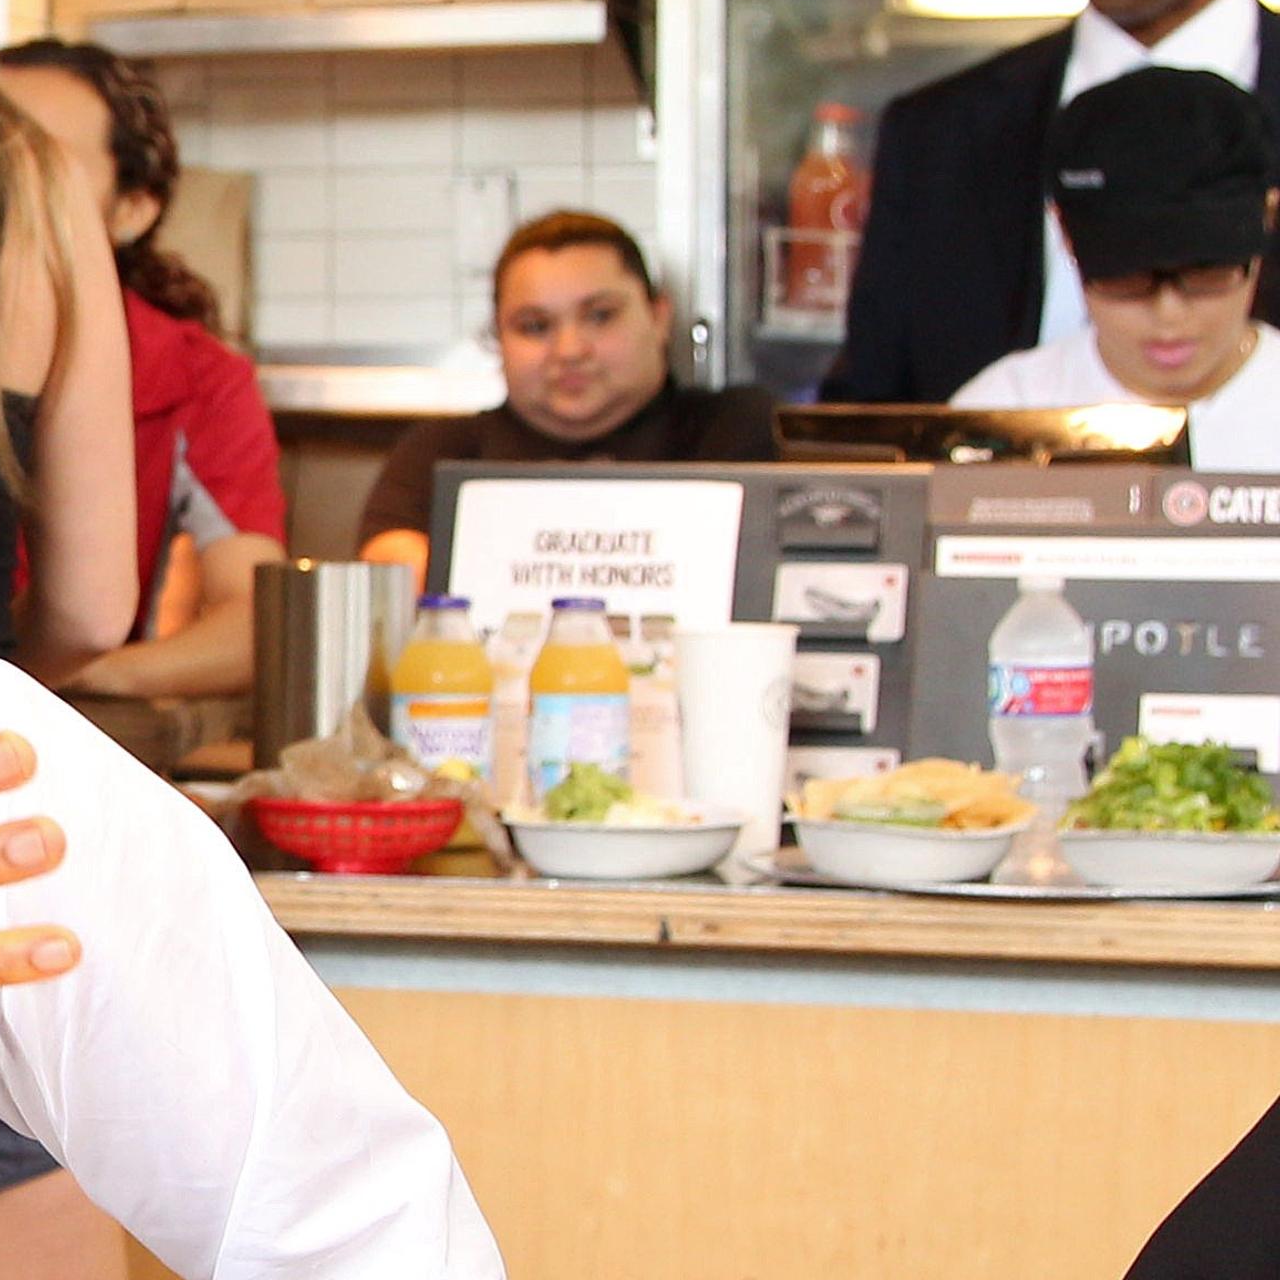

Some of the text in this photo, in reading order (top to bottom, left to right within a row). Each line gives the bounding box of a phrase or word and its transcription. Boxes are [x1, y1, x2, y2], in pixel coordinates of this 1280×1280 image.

[534, 529, 655, 556] GRADUATE
[511, 560, 675, 589] WITH HONORS
